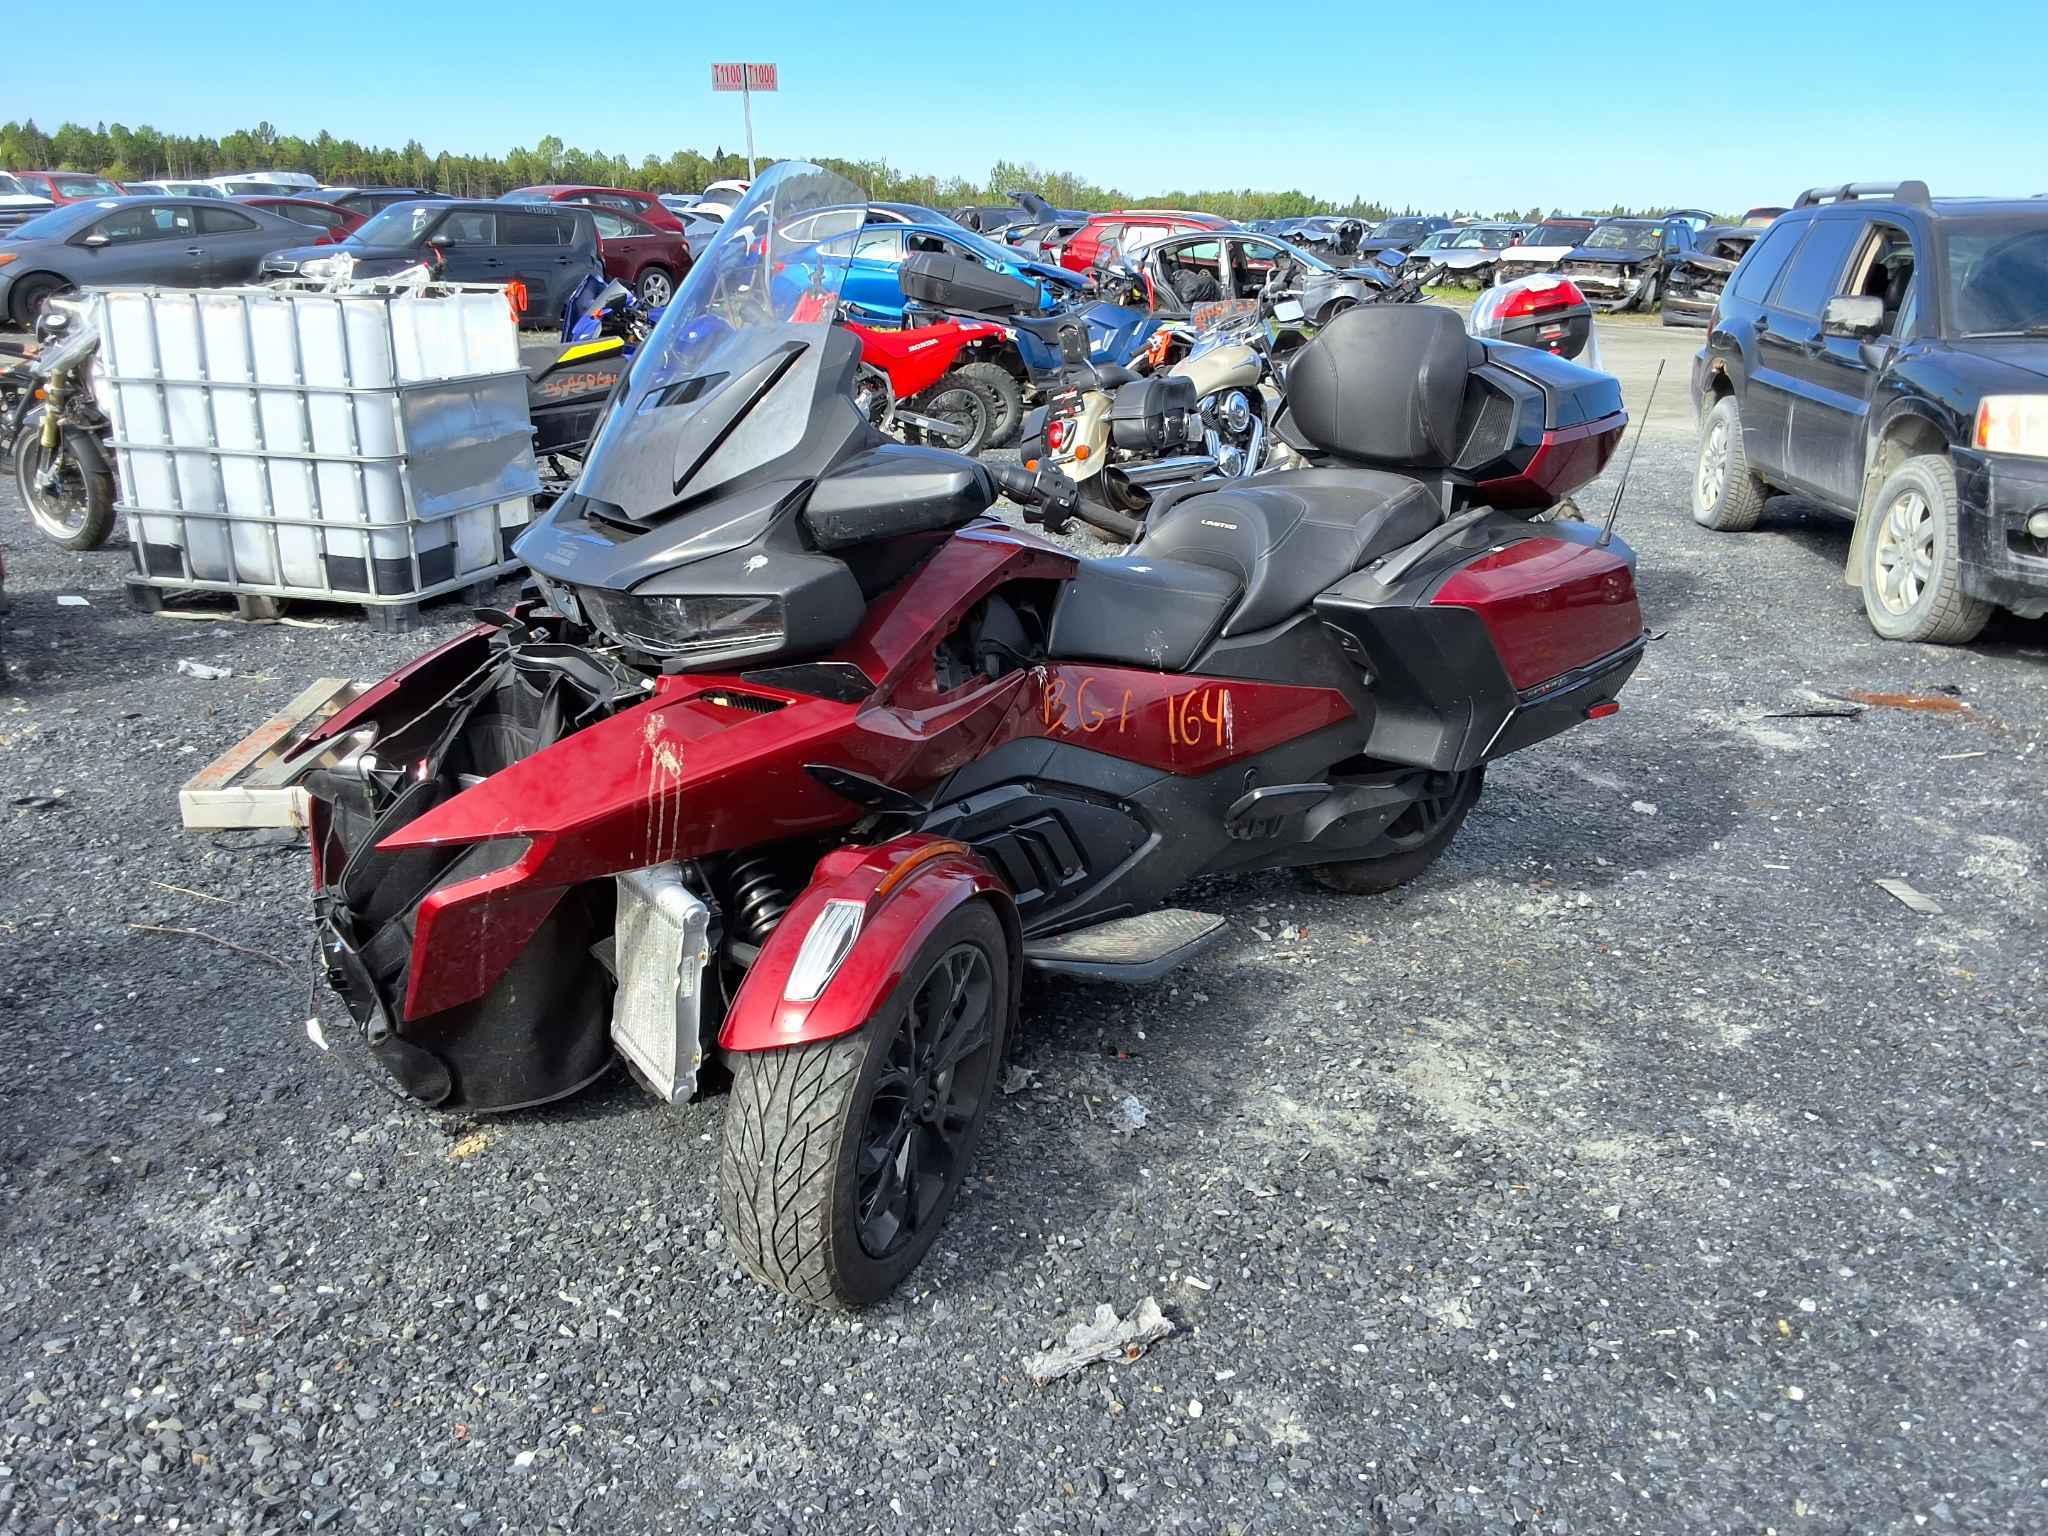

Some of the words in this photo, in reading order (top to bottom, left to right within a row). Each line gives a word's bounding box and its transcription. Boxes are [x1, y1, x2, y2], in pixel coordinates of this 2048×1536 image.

[714, 64, 741, 83] T1100
[748, 64, 774, 83] T1000
[1169, 688, 1224, 746] 164
